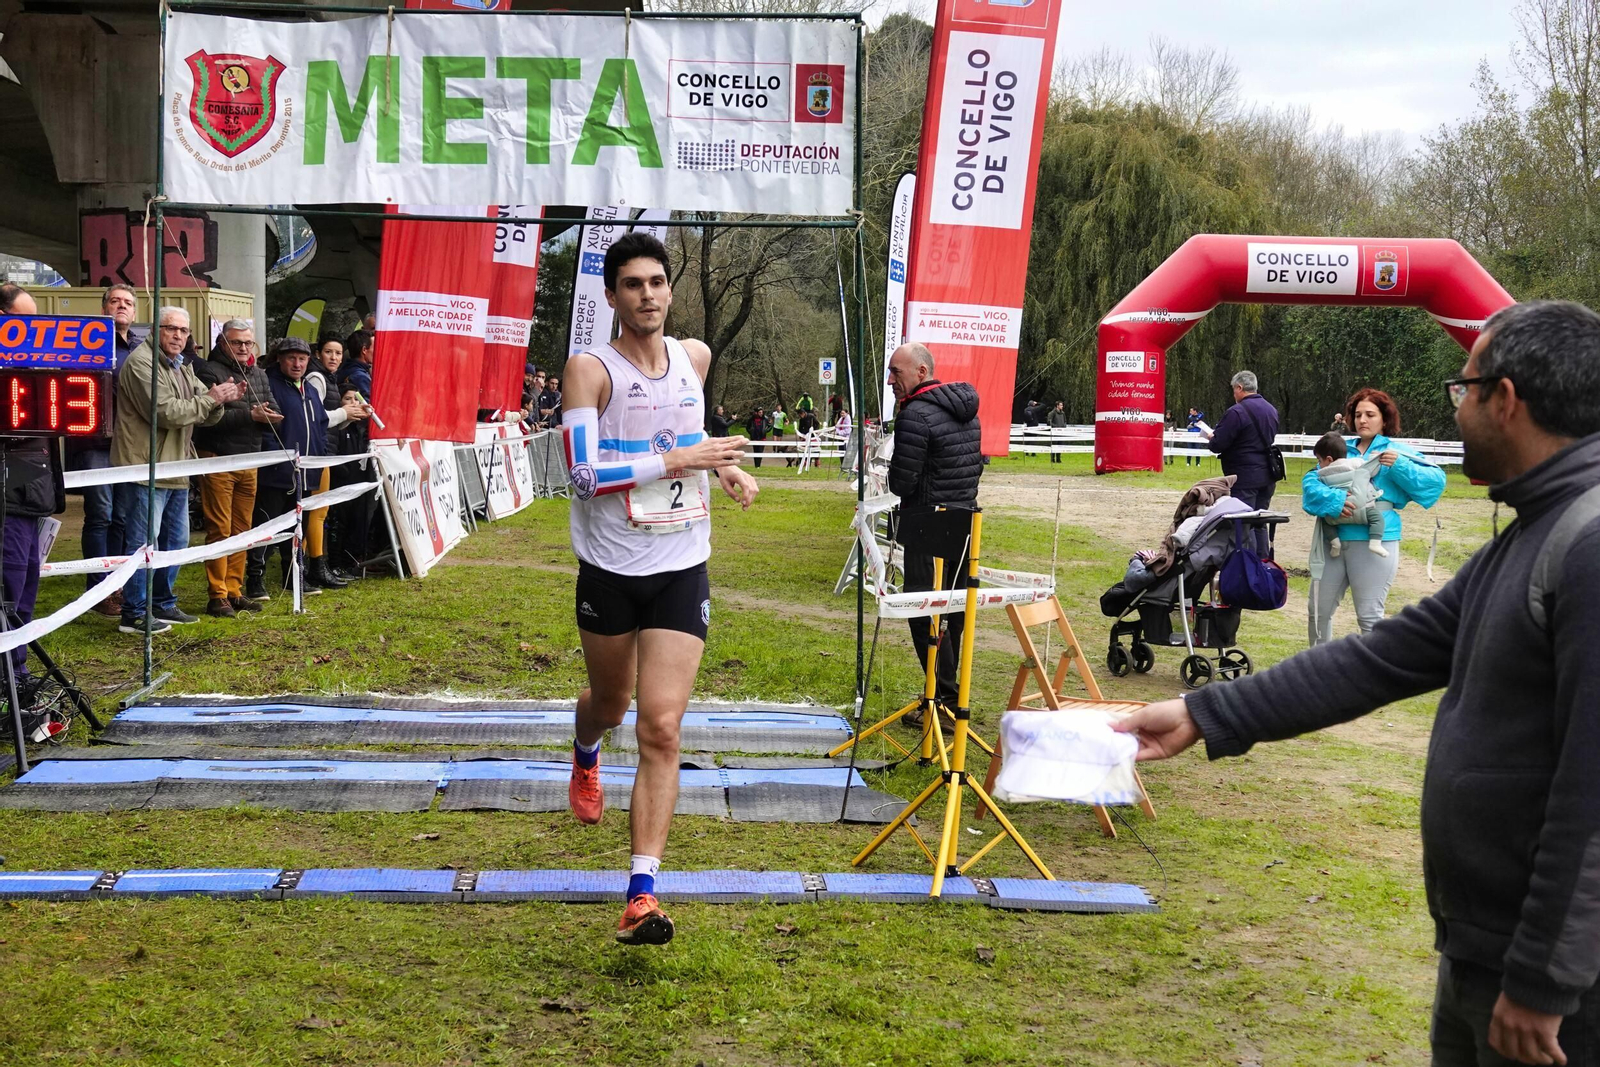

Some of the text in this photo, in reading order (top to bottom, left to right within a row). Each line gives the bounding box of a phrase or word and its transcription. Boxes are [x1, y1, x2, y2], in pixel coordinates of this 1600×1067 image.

[676, 72, 781, 90] CONCELLO
[689, 92, 768, 108] DE VIGO
[303, 55, 664, 168] META
[172, 92, 292, 171] Placa de Bronce Real Orden del Mérito Deportivo 2015
[952, 49, 990, 211] CONCELLO
[982, 71, 1018, 193] DE VIGO
[740, 142, 839, 160] DEPUTACIÓN
[740, 160, 841, 175] PONTEVEDRA
[899, 194, 909, 244] GALICIA
[892, 215, 900, 255] XUNTA
[1256, 252, 1349, 267] CONCELLO
[1266, 269, 1338, 284] DE VIGO
[388, 308, 474, 322] A MELLOR CIDADE
[574, 294, 587, 345] DEPORTE
[584, 300, 597, 345] GALEGO
[1129, 315, 1186, 325] terreo de xogo
[0, 319, 108, 350] OTEC
[418, 320, 472, 332] PARA VIVIR
[919, 320, 1007, 333] A MELLOR CIDADE
[951, 332, 1006, 344] PARA VIVIR
[1110, 380, 1155, 389] Vivimos nunha
[1108, 389, 1155, 399] cidade fermosa
[12, 377, 95, 431] 1:13
[1142, 417, 1158, 426] xogo
[669, 480, 684, 510] 2
